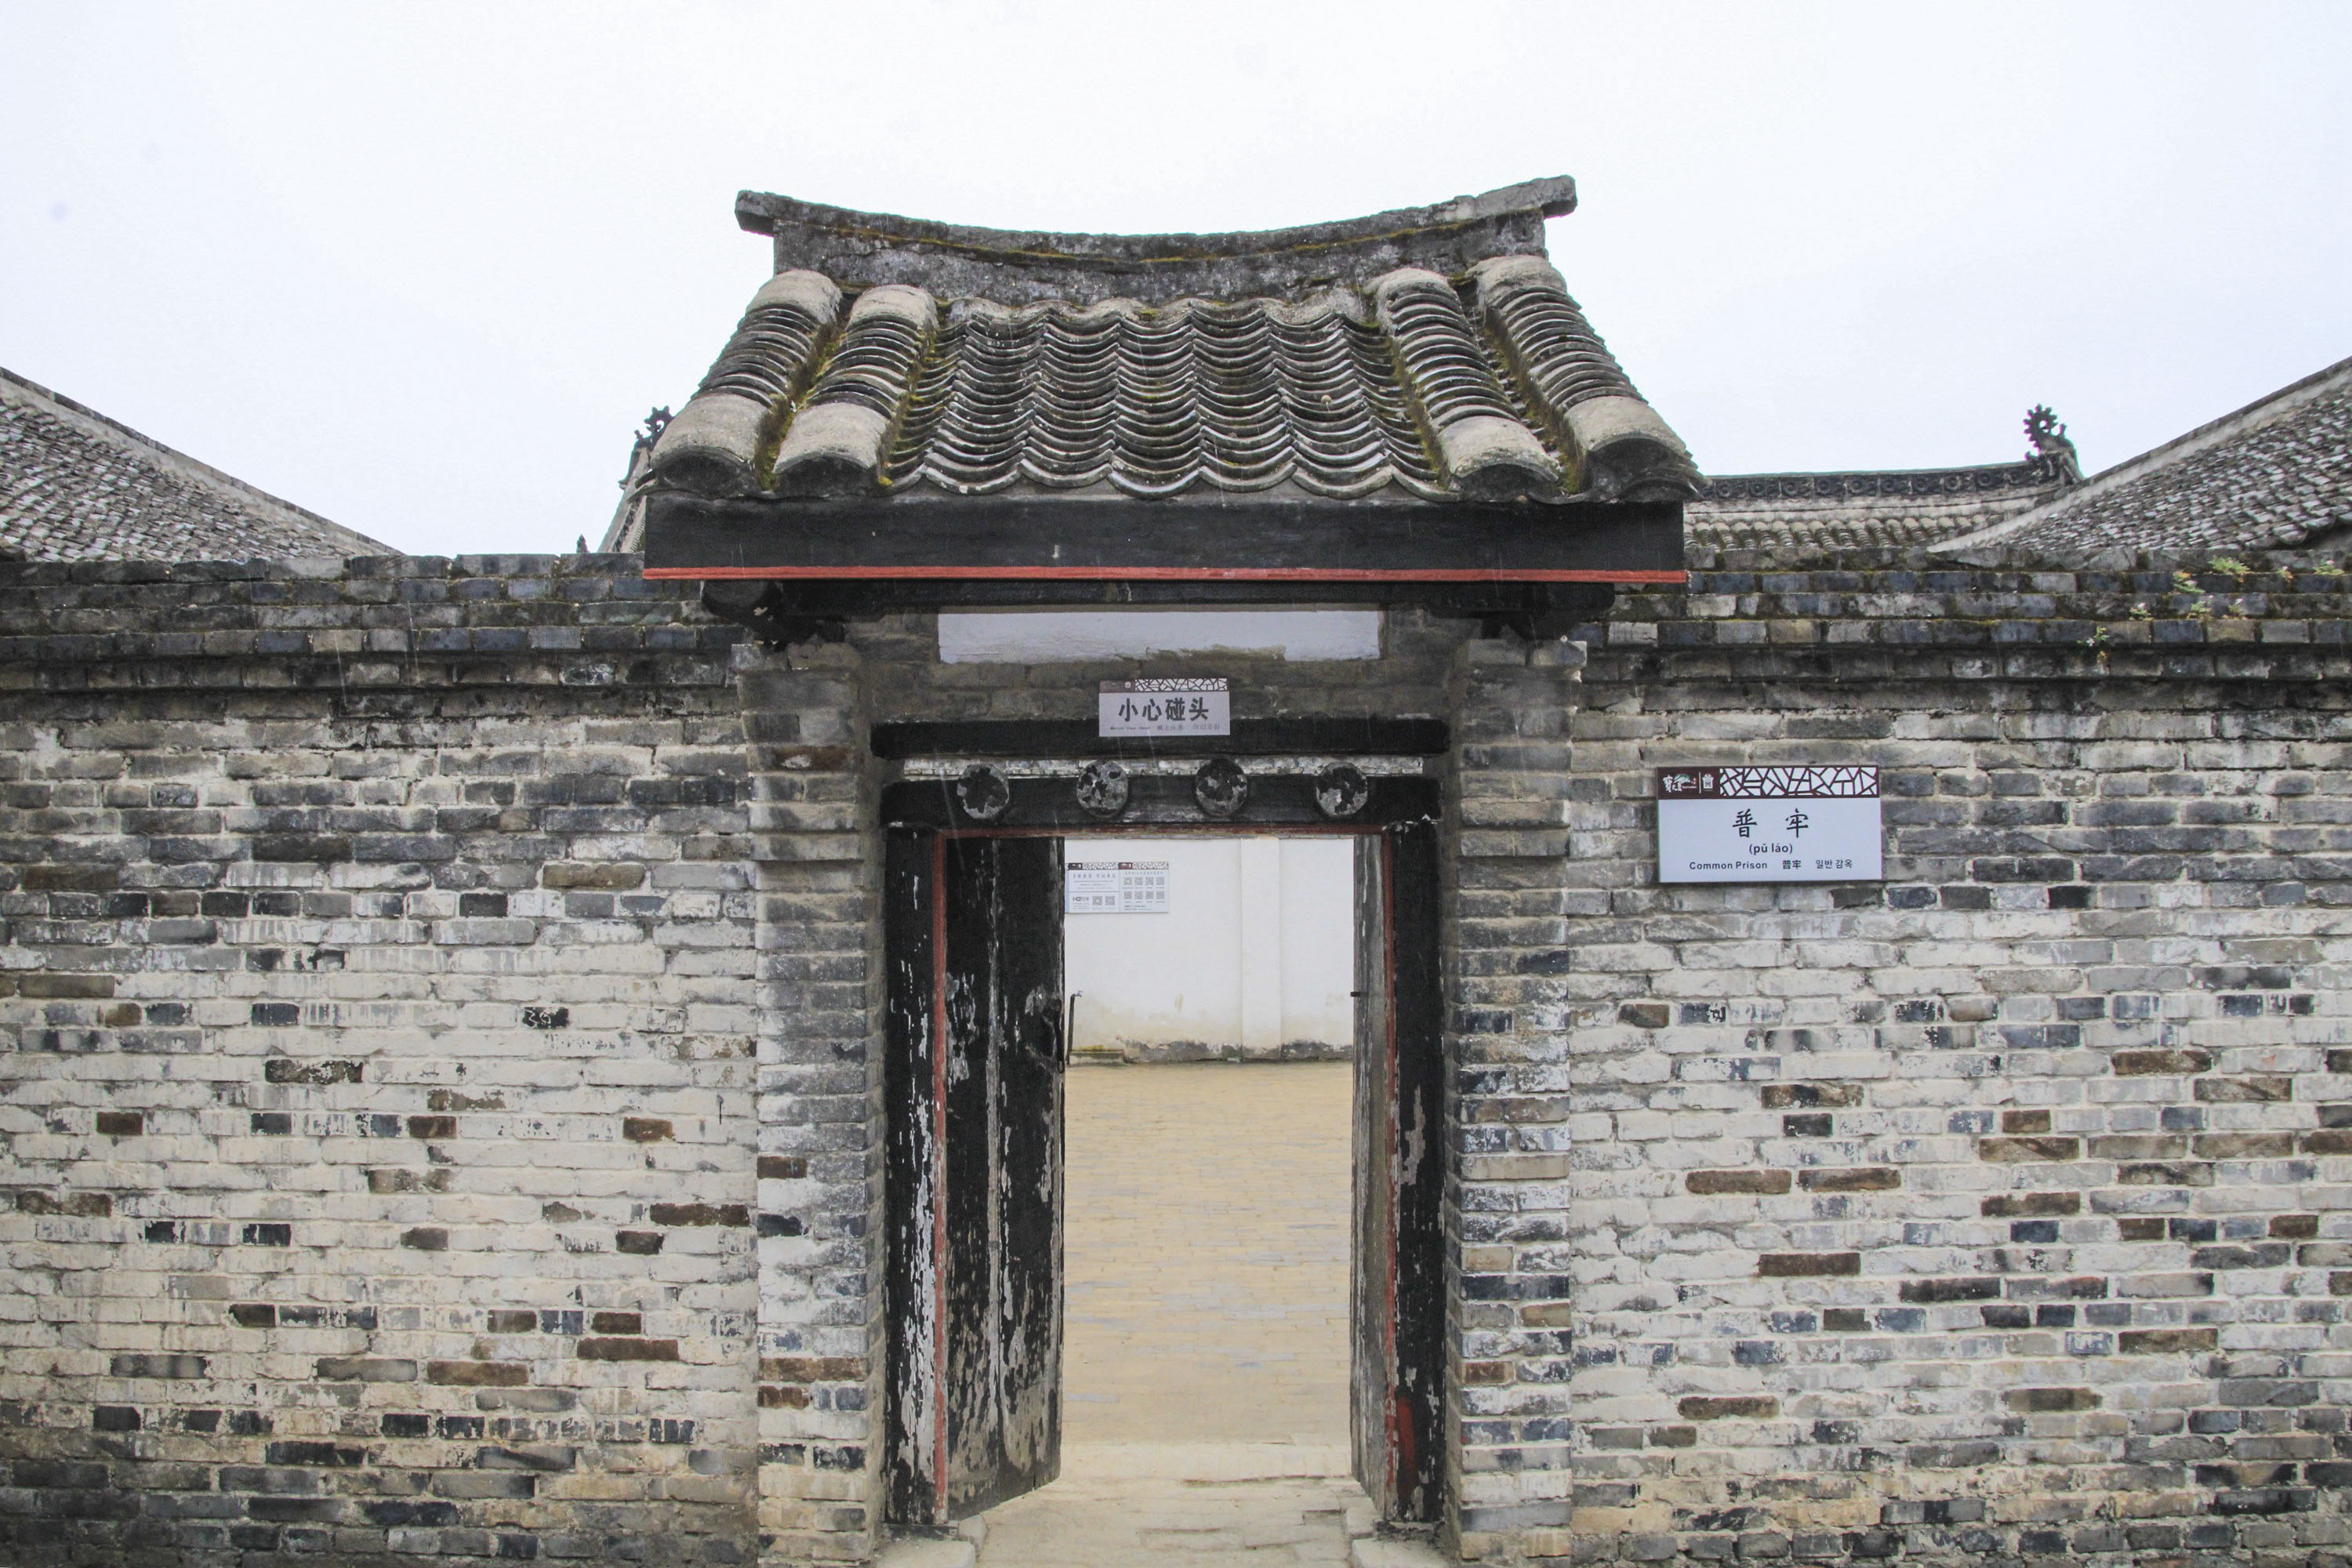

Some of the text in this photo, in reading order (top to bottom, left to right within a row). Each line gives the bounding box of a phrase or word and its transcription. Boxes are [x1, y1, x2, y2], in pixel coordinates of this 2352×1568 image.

[1118, 697, 1209, 722] 小心碰头
[1732, 808, 1809, 839] 普牢
[1771, 842, 1793, 855] láo)
[1689, 860, 1768, 870] Common Prison
[1781, 859, 1802, 869] 普牢
[1815, 858, 1853, 869] 일반 감옥
